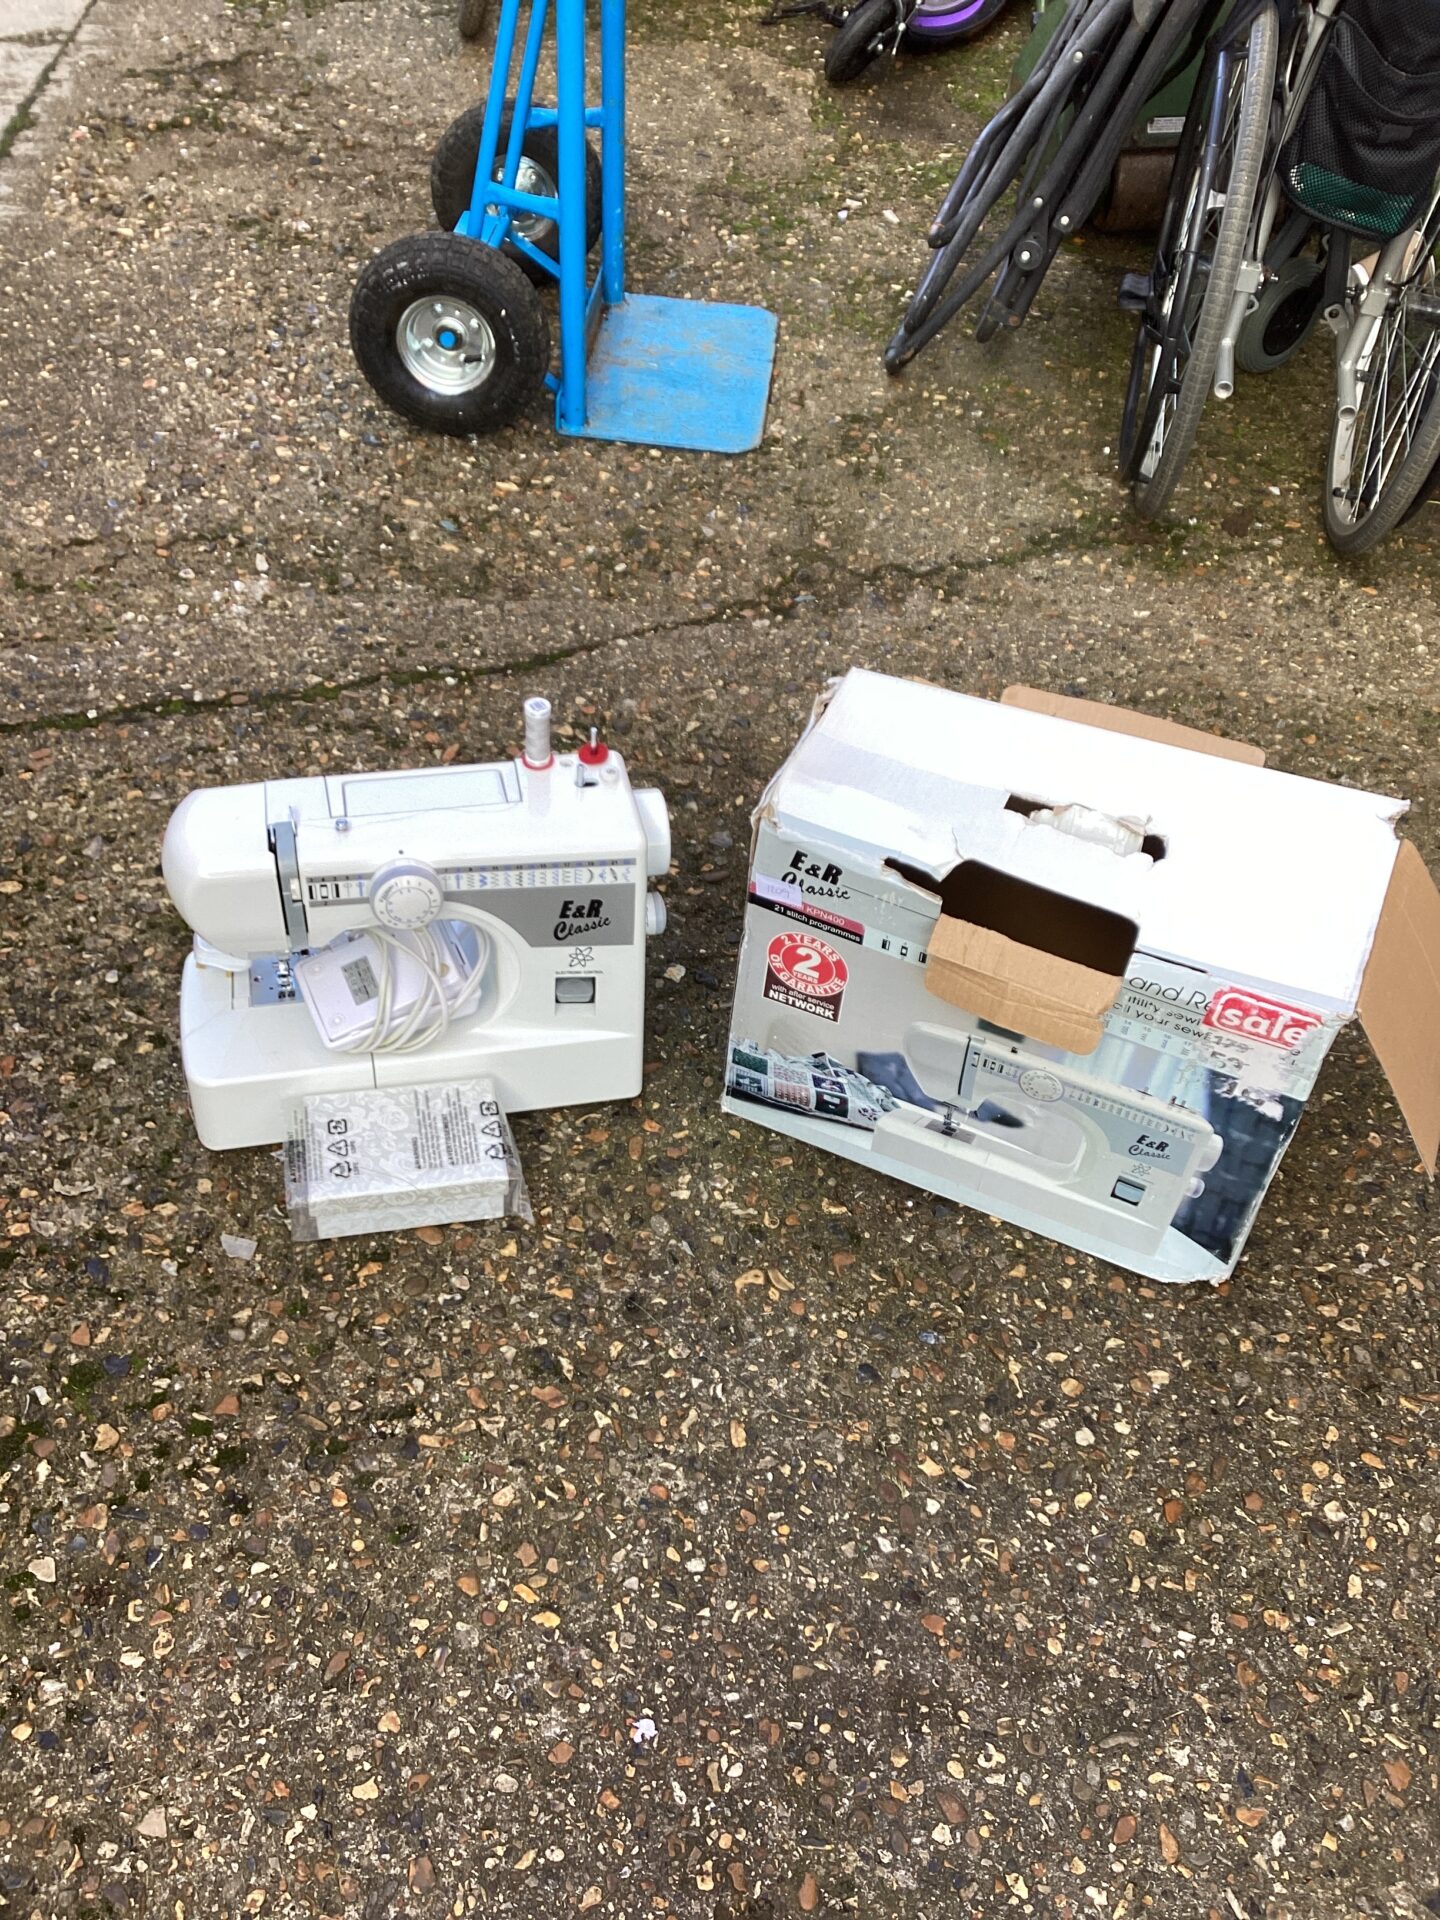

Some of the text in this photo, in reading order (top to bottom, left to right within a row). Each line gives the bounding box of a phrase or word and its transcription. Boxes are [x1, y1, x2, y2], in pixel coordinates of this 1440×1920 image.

[789, 849, 843, 885] E&R
[559, 899, 603, 919] E&R
[806, 907, 845, 926] KPN400
[553, 917, 611, 941] Classic
[774, 904, 784, 913] 21
[786, 910, 808, 923] stitch
[809, 918, 861, 942] programmes
[780, 933, 840, 962] 2 YEARS
[770, 953, 845, 995] OF GARANTEE
[792, 946, 822, 979] 2
[792, 969, 819, 984] YEARS
[1129, 976, 1185, 1002] and
[768, 989, 835, 1020] NETWORK
[771, 984, 835, 1010] with after service
[1220, 1008, 1306, 1046] sale
[1128, 1144, 1171, 1160] Classic
[1136, 1134, 1169, 1152] E&R
